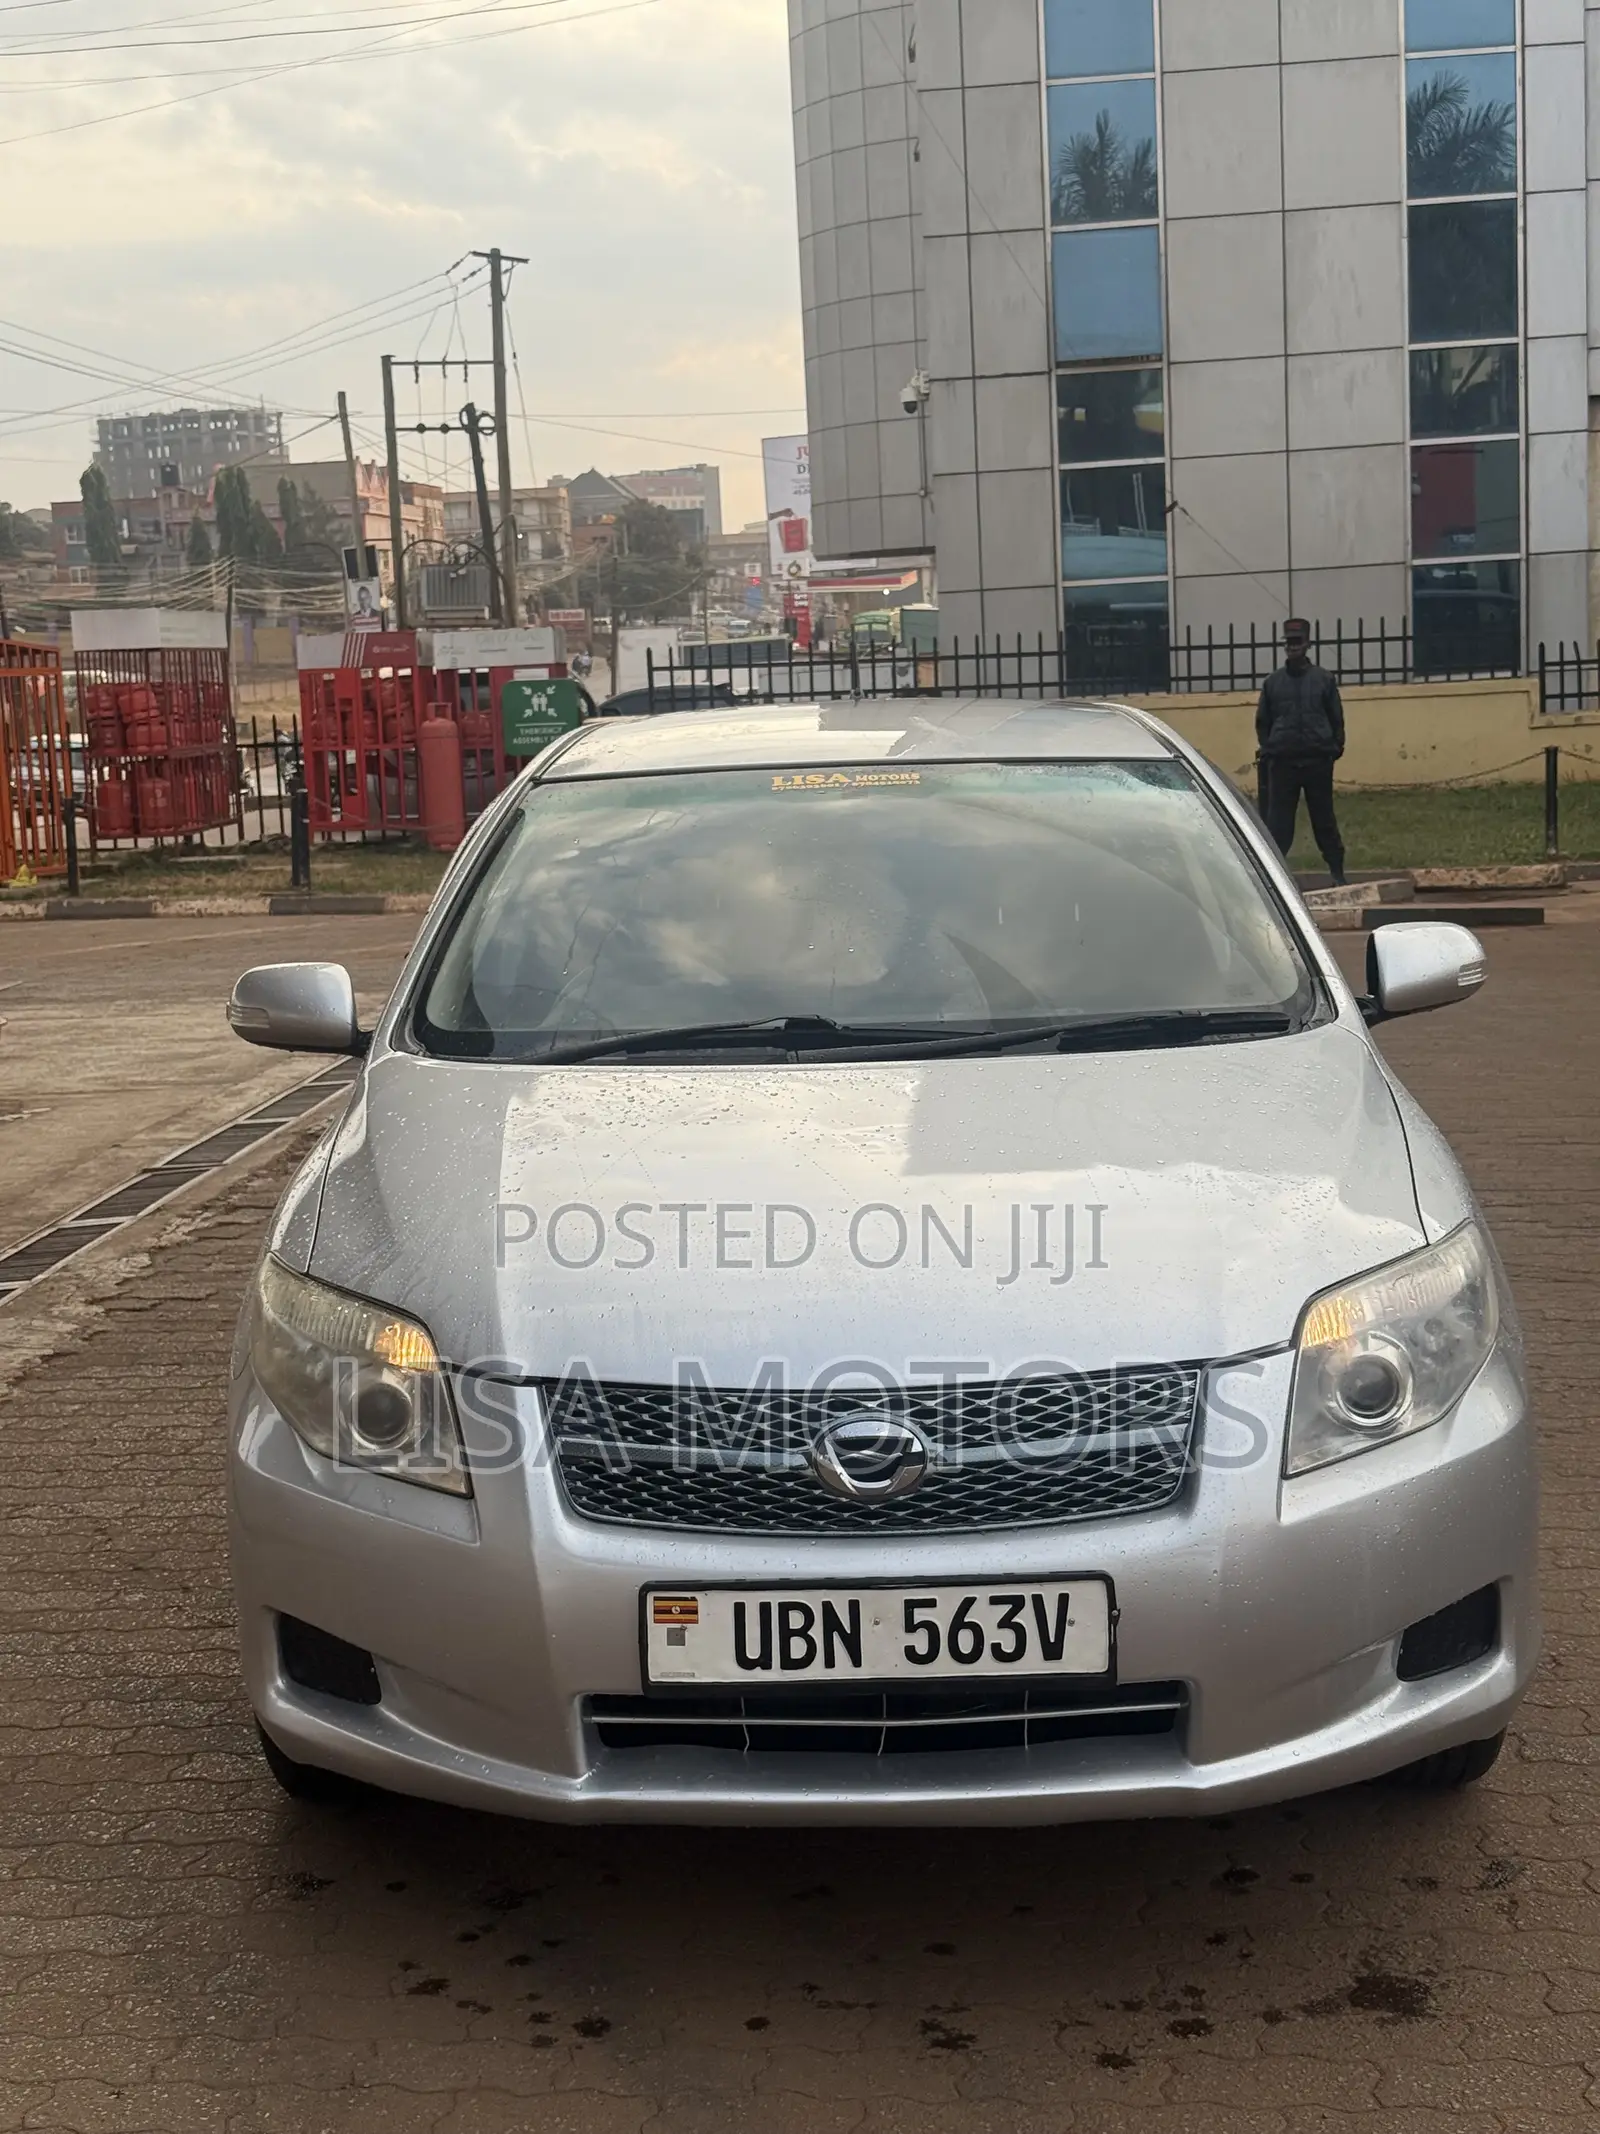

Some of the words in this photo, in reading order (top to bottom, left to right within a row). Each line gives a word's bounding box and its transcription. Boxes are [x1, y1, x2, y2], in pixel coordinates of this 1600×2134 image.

[771, 773, 852, 786] LISA
[855, 772, 920, 783] MOTORS
[732, 1598, 862, 1671] UBN
[902, 1592, 1072, 1665] 563V
